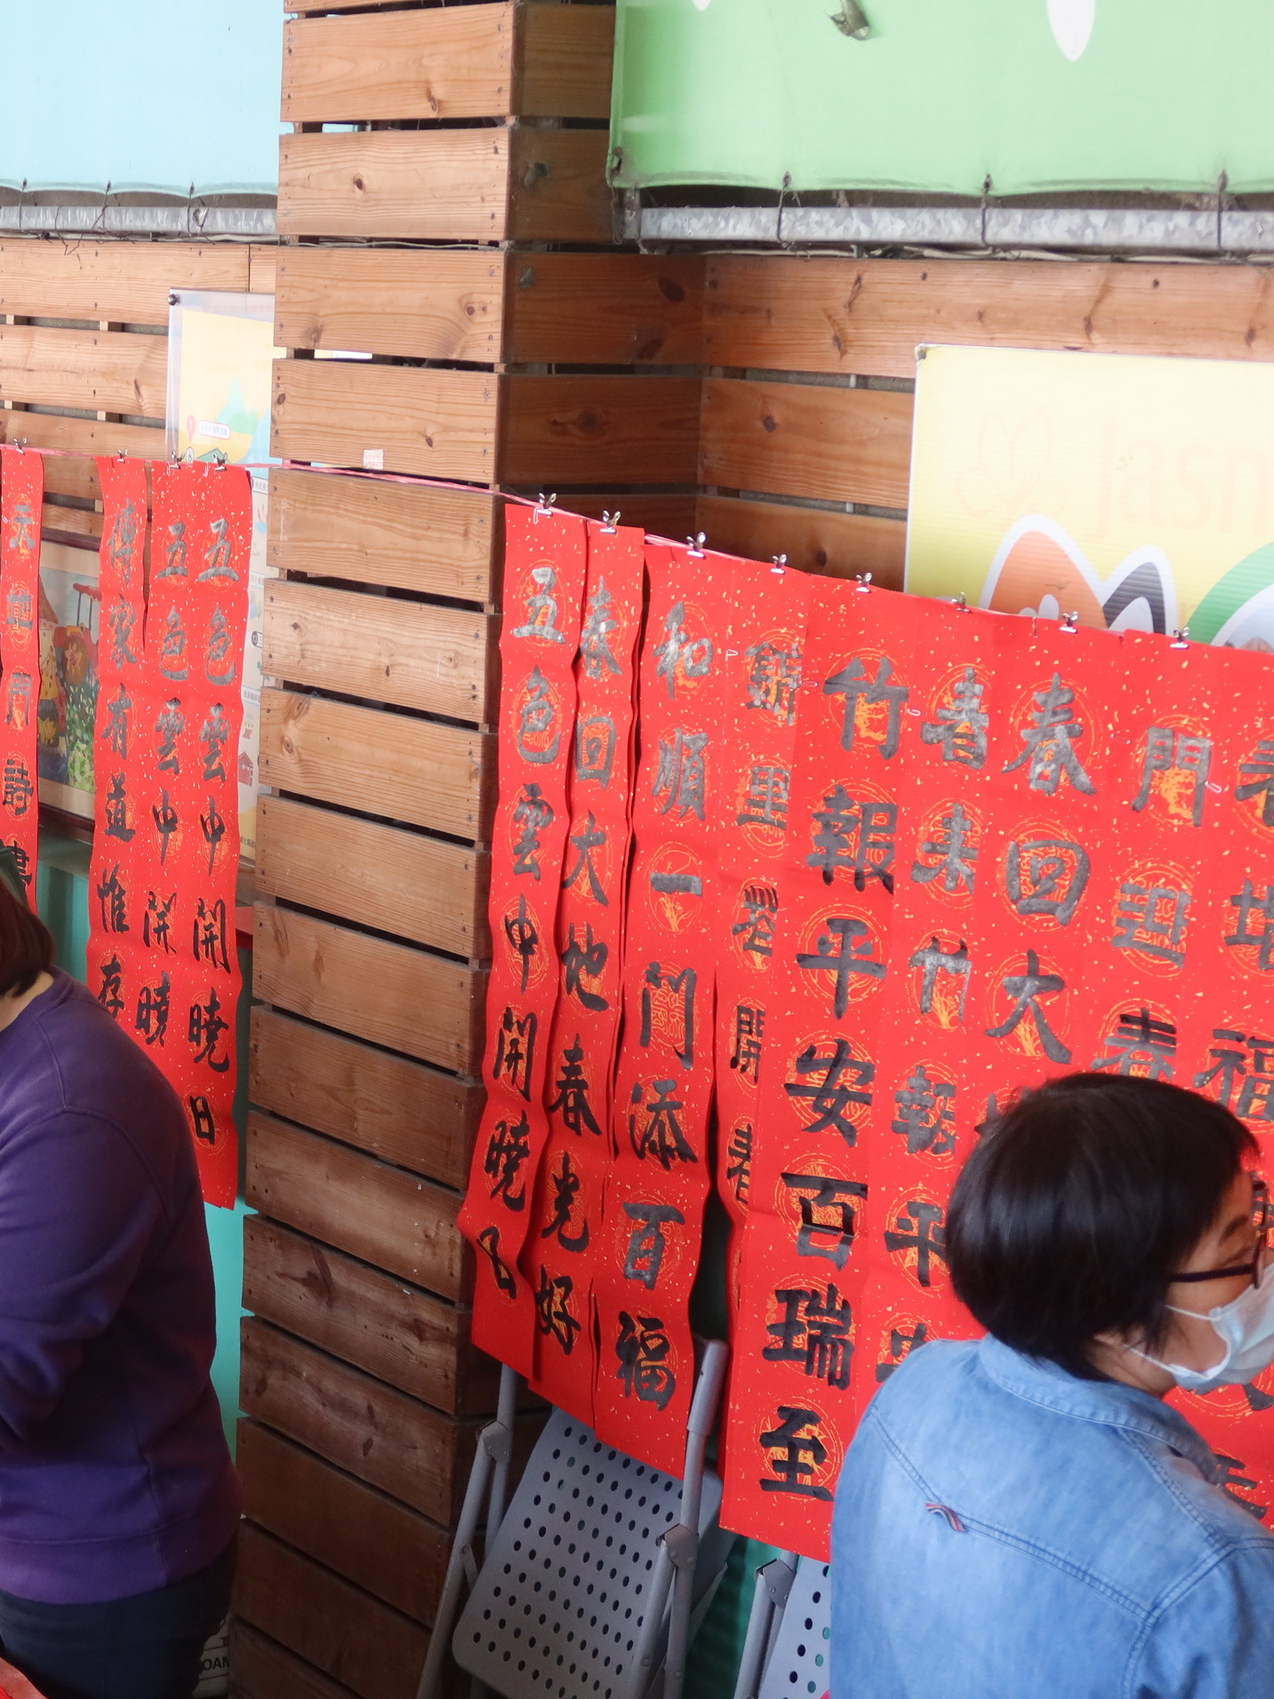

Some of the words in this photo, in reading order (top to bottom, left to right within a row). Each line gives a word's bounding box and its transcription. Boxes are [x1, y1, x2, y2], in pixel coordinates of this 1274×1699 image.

[187, 517, 242, 1146] 五色雲中開曉日
[537, 574, 623, 1355] 春回大地春光好
[615, 600, 716, 1410] 和順一門添百福
[759, 656, 910, 1502] 竹報平安百瑞至
[975, 672, 1098, 1135] 春回大
